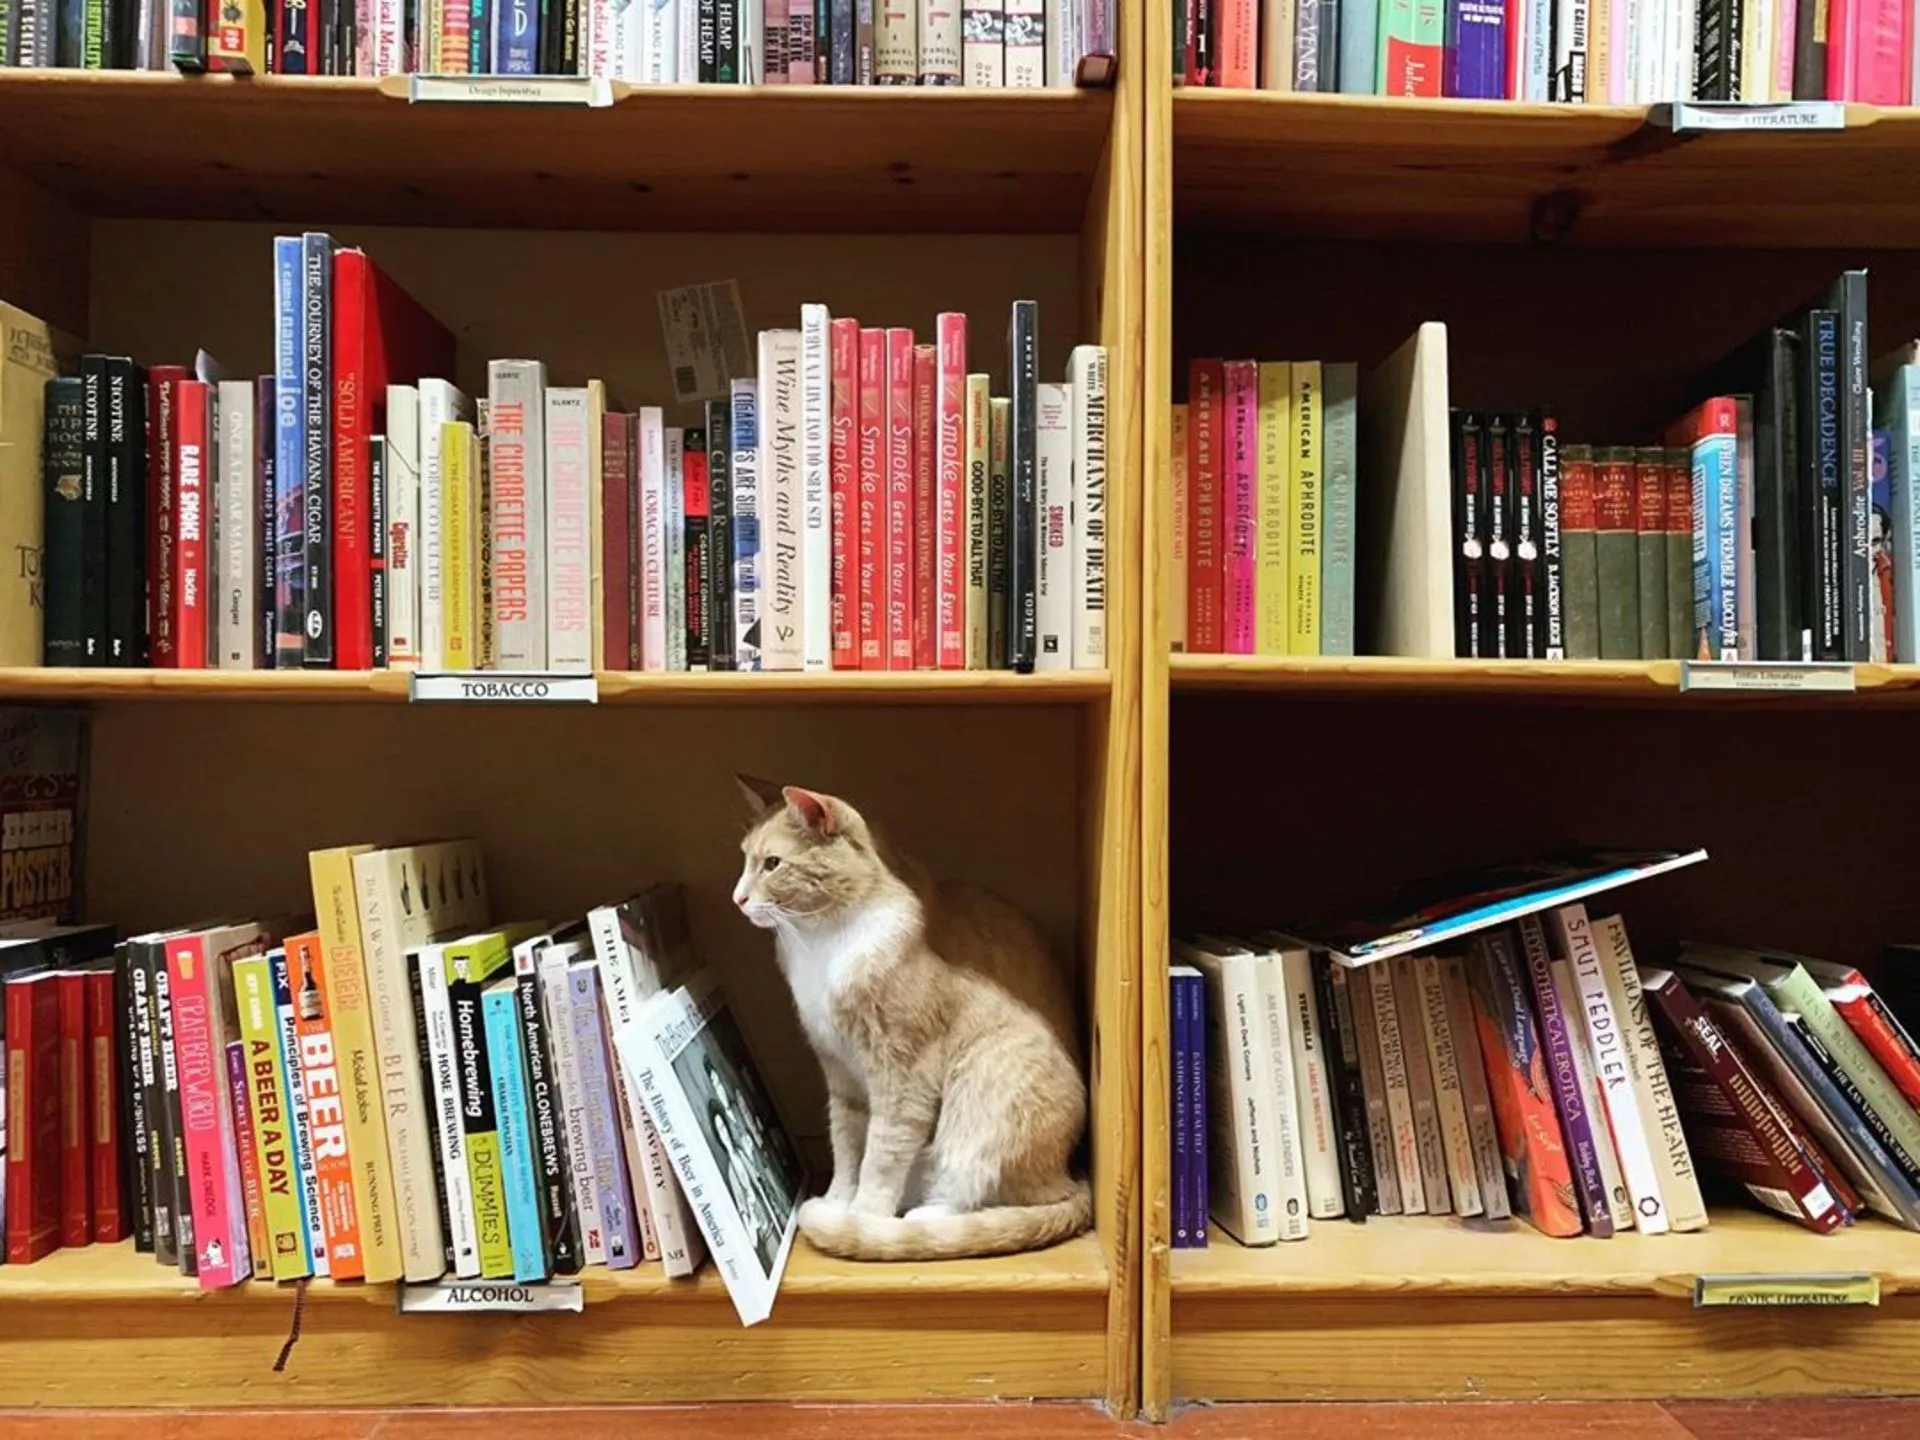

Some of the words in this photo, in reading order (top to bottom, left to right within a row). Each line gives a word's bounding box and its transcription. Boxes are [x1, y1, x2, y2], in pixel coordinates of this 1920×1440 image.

[701, 18, 715, 65] HEMP
[719, 3, 733, 50] HEMP
[1298, 26, 1319, 83] VENUS
[308, 255, 323, 288] THE
[307, 291, 323, 364] JOURNEY
[1819, 317, 1835, 366] TRUE
[308, 367, 323, 388] OF
[1025, 335, 1033, 379] SMOKE
[86, 374, 98, 440] NICOTINE
[111, 376, 124, 442] NICOTINE
[308, 392, 323, 425] THE
[777, 358, 797, 413] Wine
[494, 402, 525, 437] THE
[552, 420, 584, 455] THE
[734, 392, 757, 464] CIGARETTES
[1199, 372, 1210, 465] AMERICAN
[1234, 384, 1246, 461] AMERICAN
[1301, 381, 1311, 459] AMERICAN
[1820, 370, 1838, 487] DECADENCE
[181, 445, 199, 487] RARE
[265, 459, 274, 478] THE
[308, 429, 323, 490] HAVANA
[770, 419, 797, 485] Myths
[891, 425, 912, 493] Smoke
[943, 411, 963, 481] Smoke
[1086, 394, 1105, 512] MERCHANTS
[1543, 435, 1556, 474] CALL
[1717, 439, 1734, 479] WHEN
[265, 482, 274, 519] WORLD'S
[494, 442, 526, 543] CIGARETTE
[735, 467, 757, 492] ARE
[970, 460, 985, 525] GOOD-BYE
[1543, 476, 1558, 499] ME
[1853, 466, 1865, 492] Vol.
[181, 492, 199, 541] SMOKE
[308, 494, 323, 544] CIGAR
[553, 459, 585, 557] CIGARETTE
[645, 489, 658, 557] TOBACCO
[777, 491, 797, 536] and
[893, 500, 905, 534] Gets
[943, 490, 956, 525] Gets
[1048, 505, 1065, 548] SMOKED
[1196, 470, 1212, 567] APHRODITE
[1233, 473, 1248, 557] APHRODITE
[1265, 473, 1281, 567] APHRODITE
[1300, 470, 1315, 556] APHRODITE
[1719, 481, 1734, 528] DREAMS
[1853, 495, 1867, 558] Aphrodite
[265, 522, 274, 553] FINEST
[390, 522, 409, 569] Cigarettes
[971, 538, 984, 557] ALL
[1086, 519, 1105, 543] OF
[1544, 501, 1559, 557] SOFTLY
[265, 556, 274, 587] CIGARS
[699, 534, 708, 579] CIGARETTE
[770, 541, 797, 615] Reality
[893, 562, 905, 596] Your
[943, 551, 956, 587] Your
[971, 558, 984, 588] THAT
[1086, 547, 1106, 611] DEATH
[1720, 529, 1736, 587] TREMBLE
[230, 589, 243, 626] Cooper
[496, 549, 528, 621] PAPERS
[555, 562, 587, 634] PAPERS
[645, 560, 659, 619] CULTURE
[939, 590, 956, 626] Eyes
[700, 582, 709, 647] CONFIDENTIAL
[889, 601, 905, 634] Eyes
[1025, 592, 1034, 638] TODTRI
[462, 683, 549, 698] TOBACCO
[275, 960, 290, 989] FIX
[330, 945, 360, 1012] BEER
[1608, 923, 1650, 1027] PAVILIONS
[133, 968, 150, 1033] CRAFT
[156, 970, 173, 1037] CRAFT
[176, 995, 205, 1041] CRAFT
[519, 981, 539, 1019] North
[1236, 993, 1246, 1014] Light
[1241, 1016, 1248, 1027] on
[1567, 920, 1597, 978] SMUT
[1586, 991, 1627, 1091] PEDDLER
[251, 1040, 270, 1055] A
[555, 1003, 572, 1057] illustrated
[1240, 1028, 1250, 1049] Dark
[1523, 927, 1565, 1048] HYPOTHETICAL
[1555, 1052, 1582, 1121] EROTICA
[1637, 1026, 1656, 1051] OF
[1698, 1016, 1722, 1056] SEAL
[138, 1035, 155, 1087] BEER
[162, 1040, 178, 1092] BEER
[181, 1042, 210, 1078] BEER
[284, 1015, 304, 1090] Principles
[437, 1053, 452, 1094] HOME
[457, 999, 485, 1117] Homebrewing
[525, 1022, 545, 1079] American
[1242, 1050, 1254, 1081] Corners
[254, 1060, 279, 1124] BEER
[294, 1092, 306, 1107] of
[303, 1032, 347, 1160] BEER
[561, 1059, 577, 1093] guide
[568, 1094, 579, 1105] to
[638, 1066, 655, 1090] The
[1645, 1058, 1670, 1103] THE
[184, 1082, 215, 1130] WORLD
[443, 1097, 461, 1160] BREWING
[534, 1081, 560, 1176] CLONEBREWS
[643, 1092, 675, 1136] History
[1832, 1066, 1848, 1084] THE
[1843, 1085, 1862, 1104] LAS
[1856, 1103, 1883, 1130] VEGAS
[1880, 1130, 1916, 1174] QUARTET
[262, 1129, 281, 1146] A
[296, 1112, 314, 1171] Brewing
[566, 1107, 591, 1173] brewing
[667, 1138, 681, 1151] of
[1658, 1106, 1692, 1180] HEART
[200, 1151, 212, 1178] MARK
[266, 1151, 289, 1195] DAY
[365, 1160, 381, 1214] RUNNING
[672, 1155, 692, 1182] Beer
[204, 1180, 216, 1217] DREDGE
[304, 1175, 322, 1232] Science
[472, 1150, 501, 1245] DUMMIES
[548, 1185, 563, 1217] Russell
[578, 1175, 597, 1212] beer
[687, 1186, 697, 1195] in
[371, 1214, 385, 1248] PRESS
[699, 1197, 726, 1247] America
[447, 1287, 534, 1303] ALCOHOL
